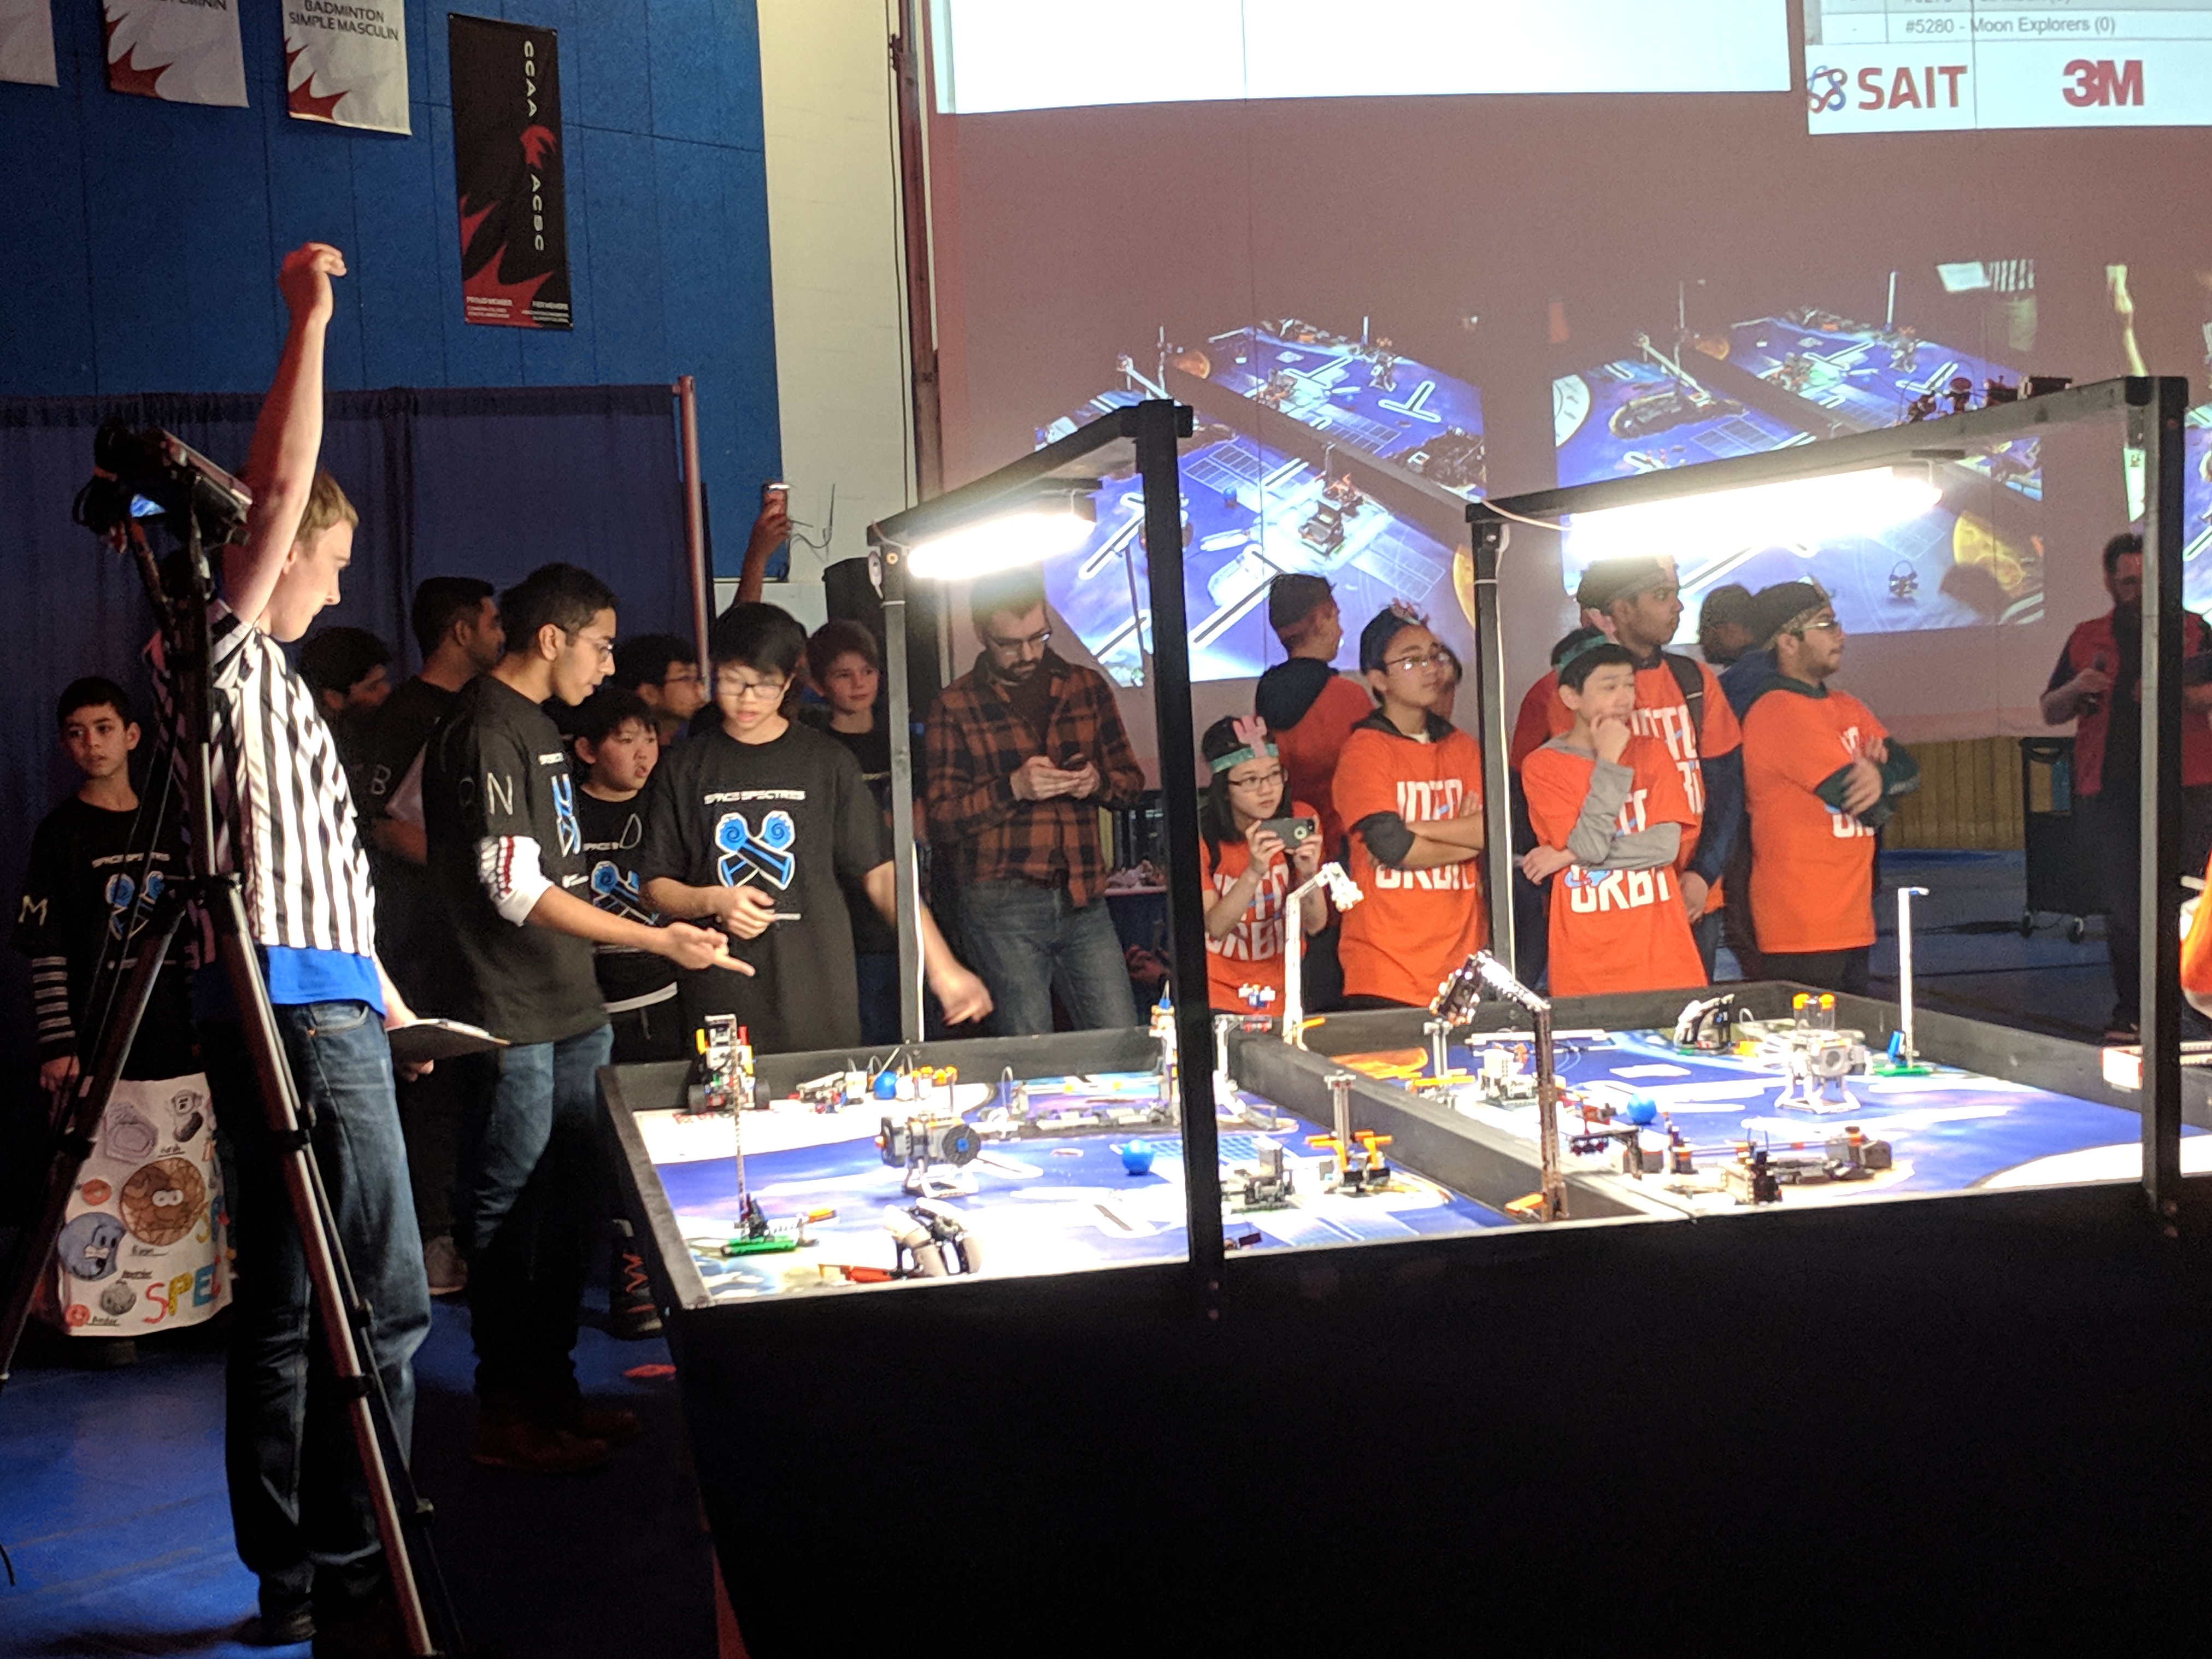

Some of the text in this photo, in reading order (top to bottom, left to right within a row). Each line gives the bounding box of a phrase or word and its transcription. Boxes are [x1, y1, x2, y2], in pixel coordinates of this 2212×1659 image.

[289, 11, 399, 41] SIMPLE MASCULIN
[304, 0, 385, 22] BADMINTON
[1905, 19, 1955, 33] #5280
[1970, 18, 2014, 32] Moon
[2017, 17, 2090, 34] Explorers
[2094, 16, 2116, 32] (0)
[524, 40, 538, 117] CCAA
[1858, 65, 1968, 110] SAIT
[2062, 59, 2145, 108] 3M
[487, 772, 513, 815] N
[18, 895, 48, 926] M
